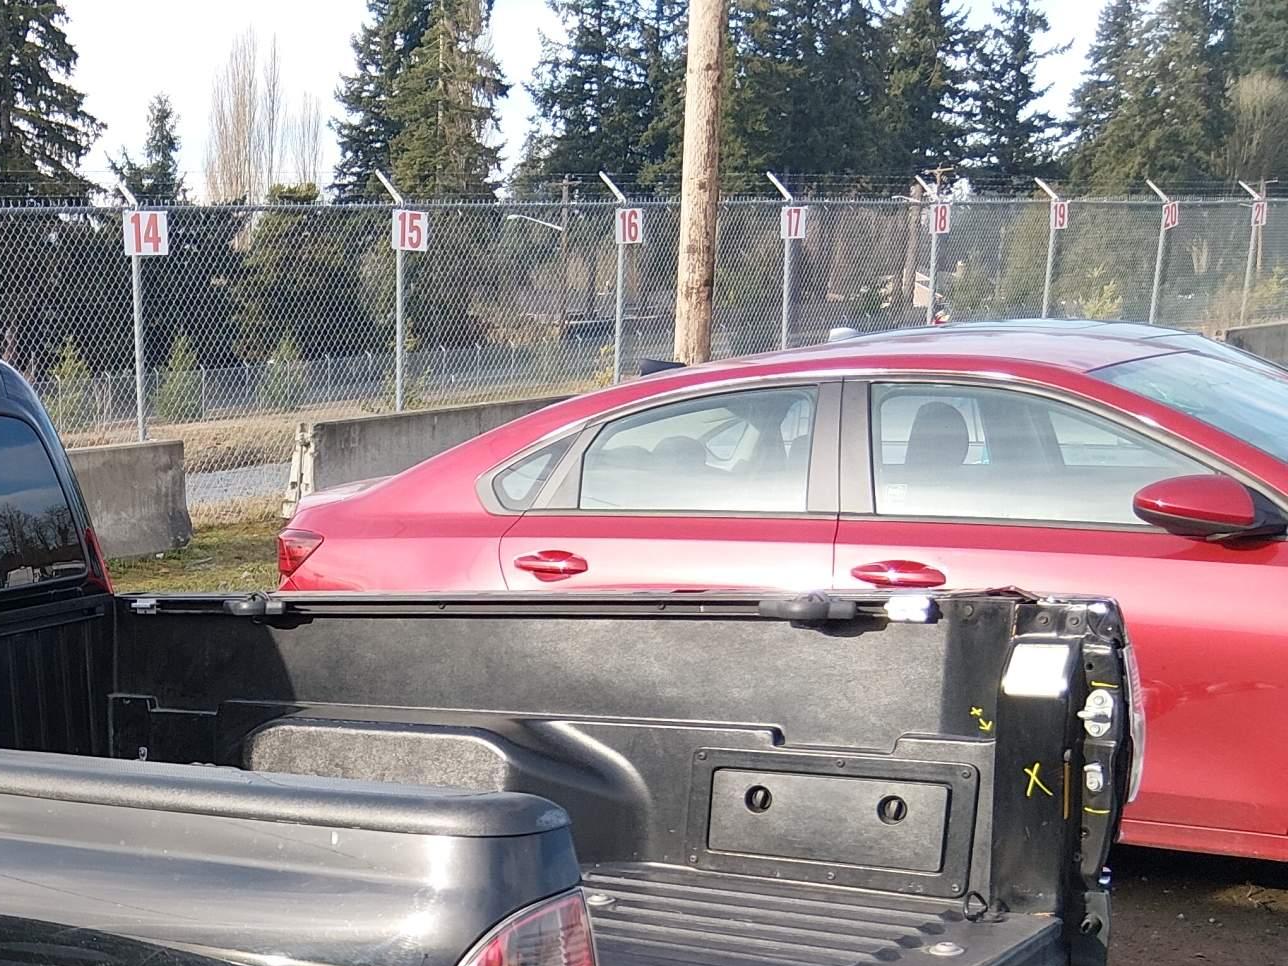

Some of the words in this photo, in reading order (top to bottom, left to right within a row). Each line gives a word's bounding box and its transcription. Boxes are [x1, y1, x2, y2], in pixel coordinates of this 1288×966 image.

[620, 209, 639, 242] 16
[786, 208, 801, 237] 17
[934, 205, 947, 232] 18
[1054, 203, 1066, 228] 19
[1163, 203, 1177, 229] 20
[1254, 203, 1265, 225] 21
[130, 213, 162, 253] 14
[398, 212, 422, 249] 15
